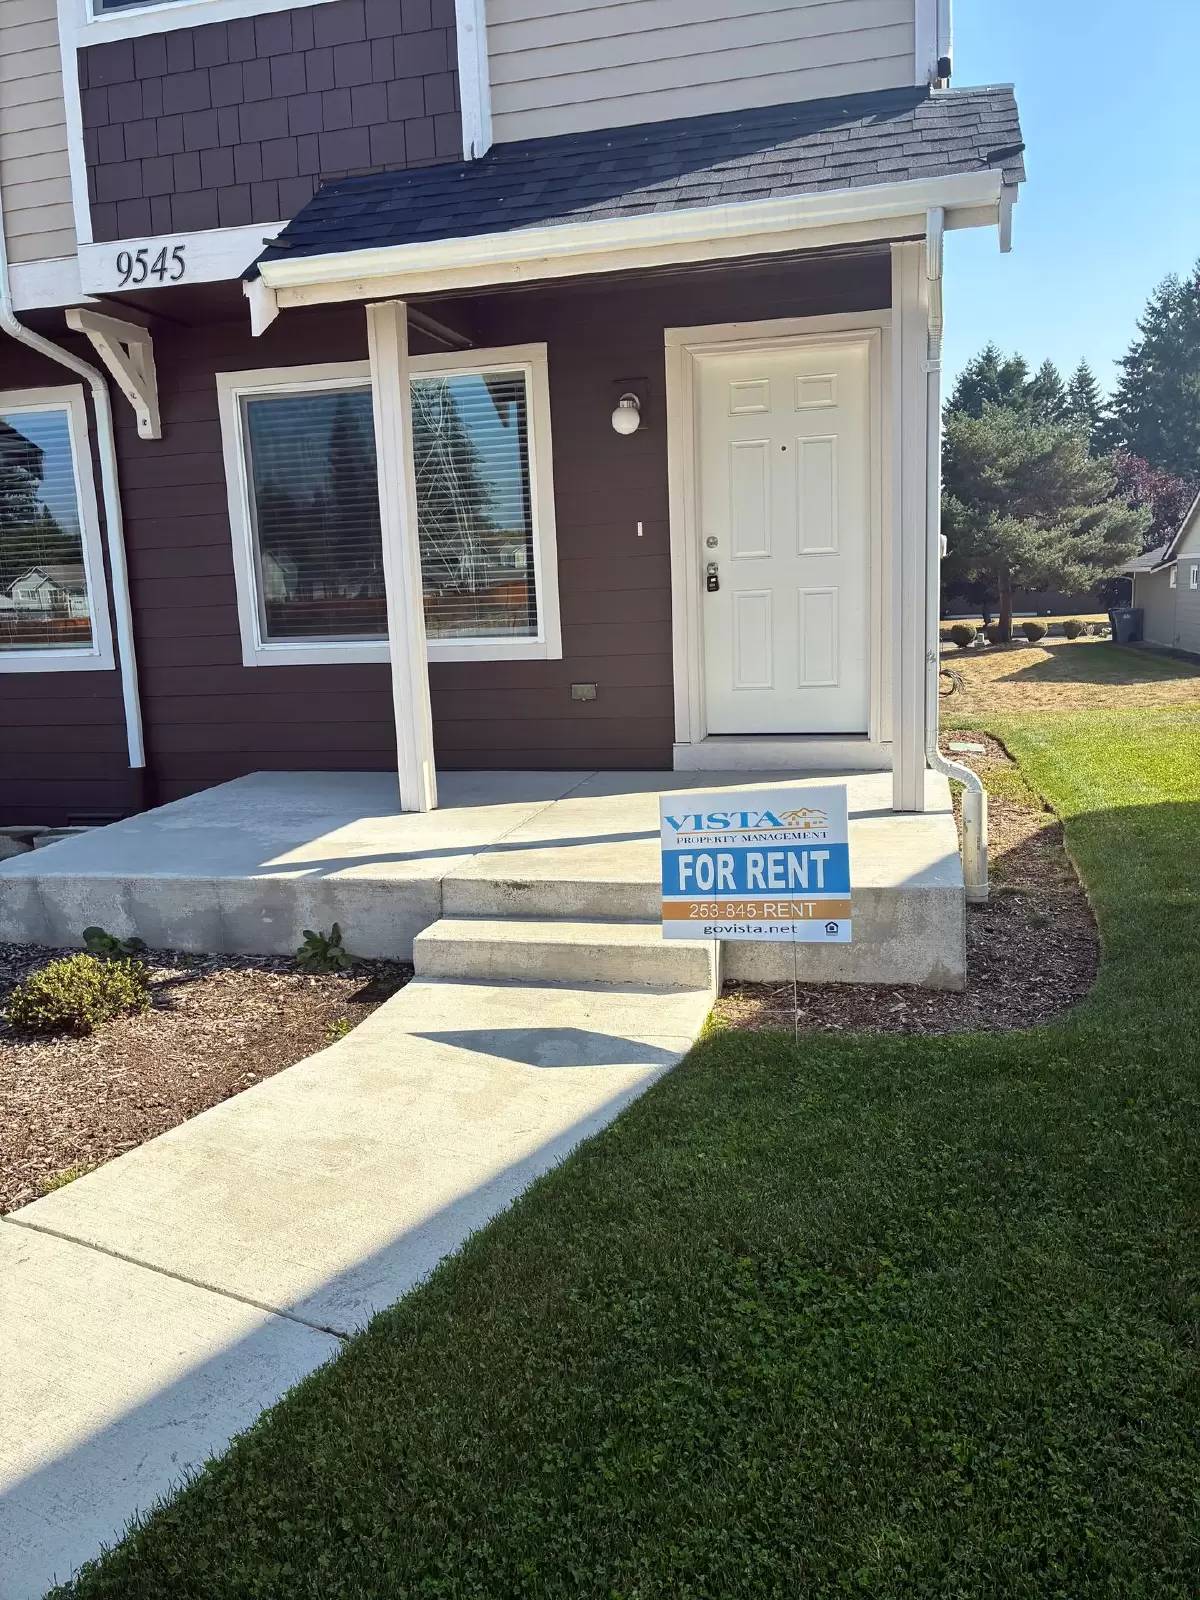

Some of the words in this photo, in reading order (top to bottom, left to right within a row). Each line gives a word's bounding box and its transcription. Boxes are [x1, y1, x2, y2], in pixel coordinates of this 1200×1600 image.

[116, 244, 186, 288] 9545
[664, 810, 784, 832] VISTA
[677, 835, 739, 845] PROPERTY
[741, 831, 829, 843] MANAGEMENT
[678, 853, 737, 891] FOR
[746, 850, 830, 890] RENT
[689, 902, 817, 918] 253-845-RENT
[703, 923, 798, 935] govista.net
